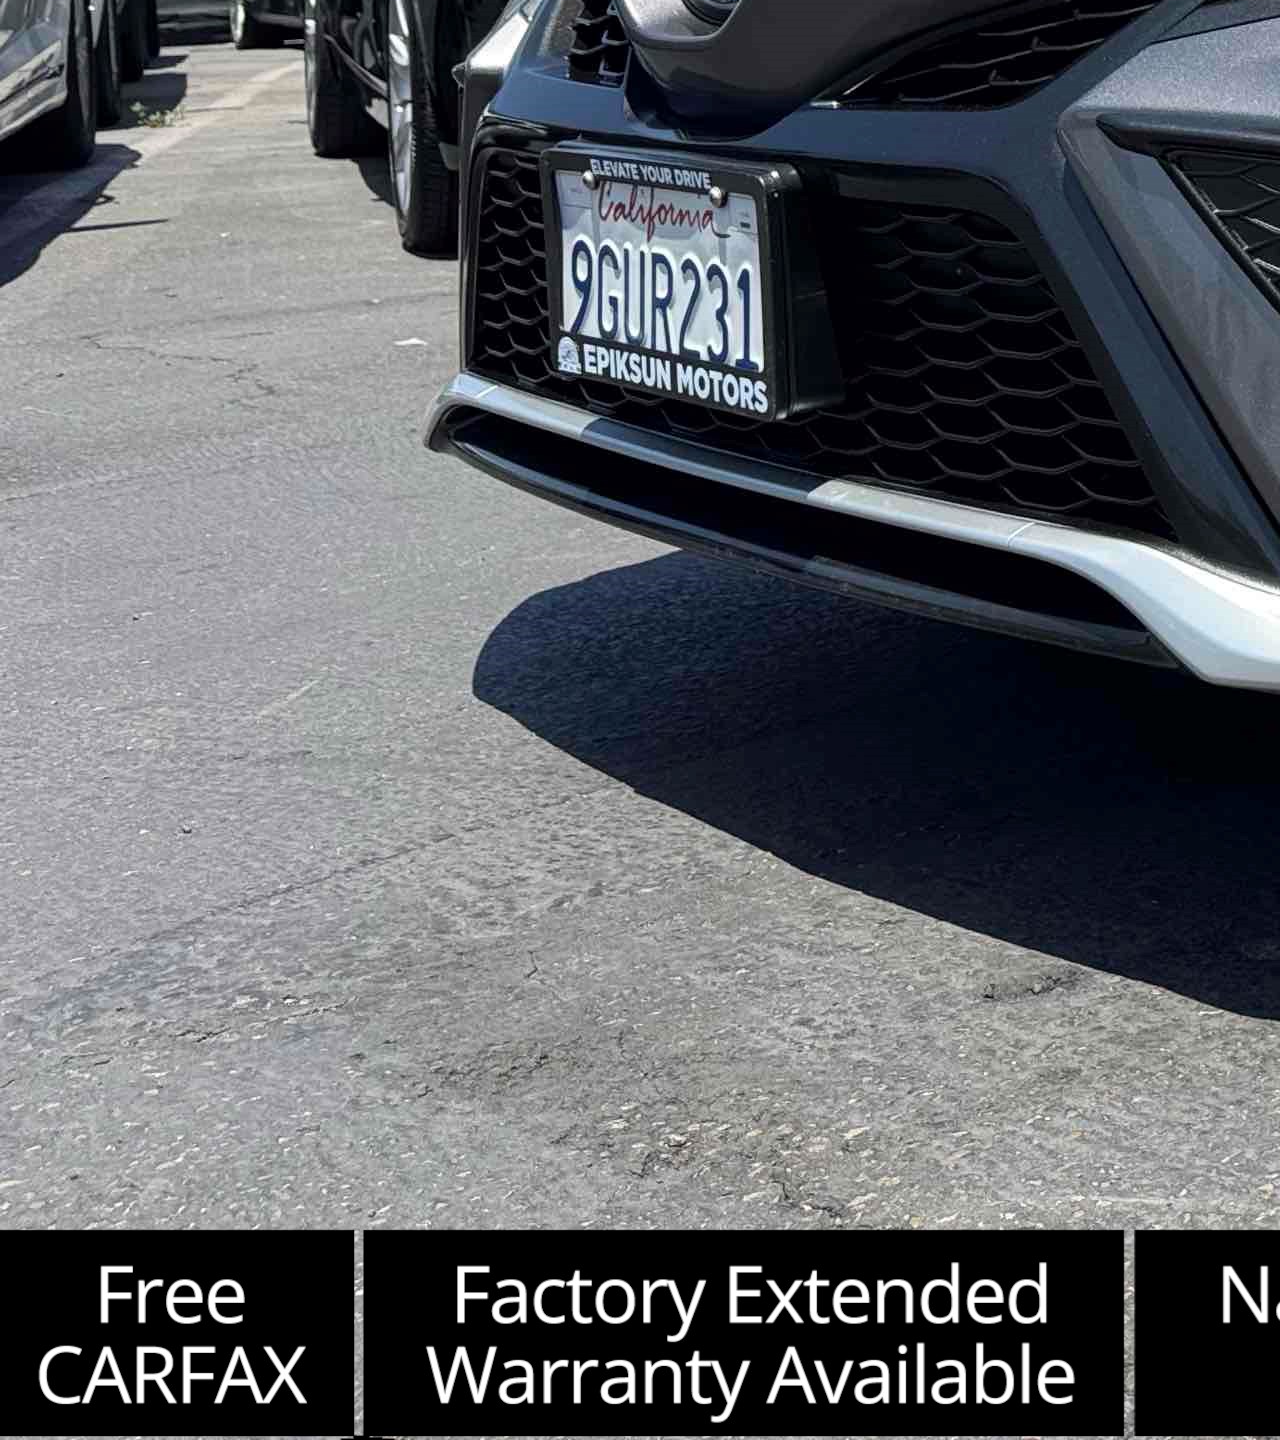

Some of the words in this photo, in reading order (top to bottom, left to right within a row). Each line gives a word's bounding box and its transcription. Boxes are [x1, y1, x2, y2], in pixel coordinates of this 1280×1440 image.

[590, 159, 640, 182] ELEVATE
[640, 163, 673, 185] YOUR
[674, 169, 712, 190] DRIVE
[599, 181, 731, 242] California
[571, 239, 760, 372] 9GUR231
[583, 343, 672, 391] EPIKSUN
[677, 362, 769, 413] MOTORS
